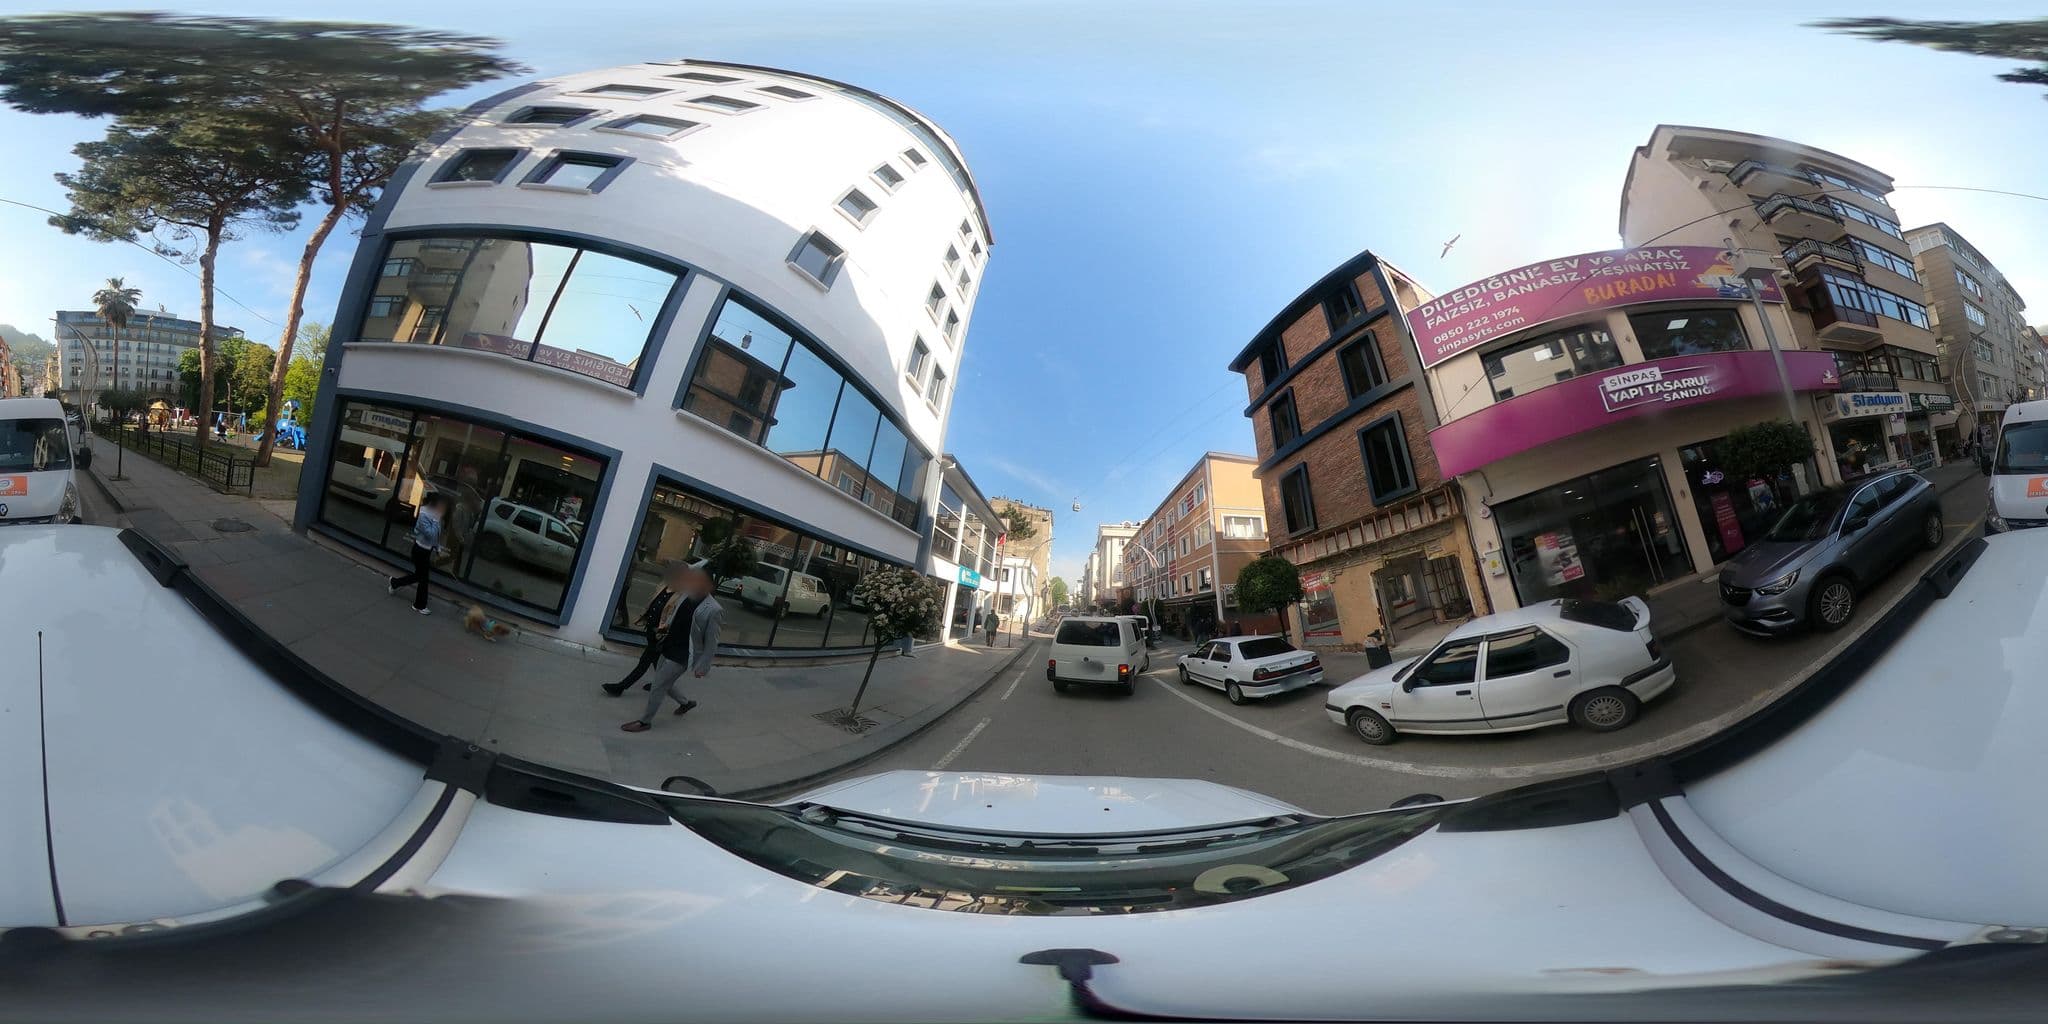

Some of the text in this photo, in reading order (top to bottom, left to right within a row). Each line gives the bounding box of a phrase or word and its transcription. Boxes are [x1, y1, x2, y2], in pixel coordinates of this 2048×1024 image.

[1549, 258, 1579, 272] EV
[1588, 256, 1614, 266] ve
[1625, 249, 1684, 262] ARAÇ
[1584, 272, 1677, 305] BURADA!
[1426, 298, 1491, 329] FAİZSİZ,
[1433, 306, 1520, 345] 0850 222 1974
[1437, 316, 1525, 355] sinpasyts.com
[1609, 370, 1657, 387] SİNPAŞ
[1609, 386, 1644, 403] YAPI
